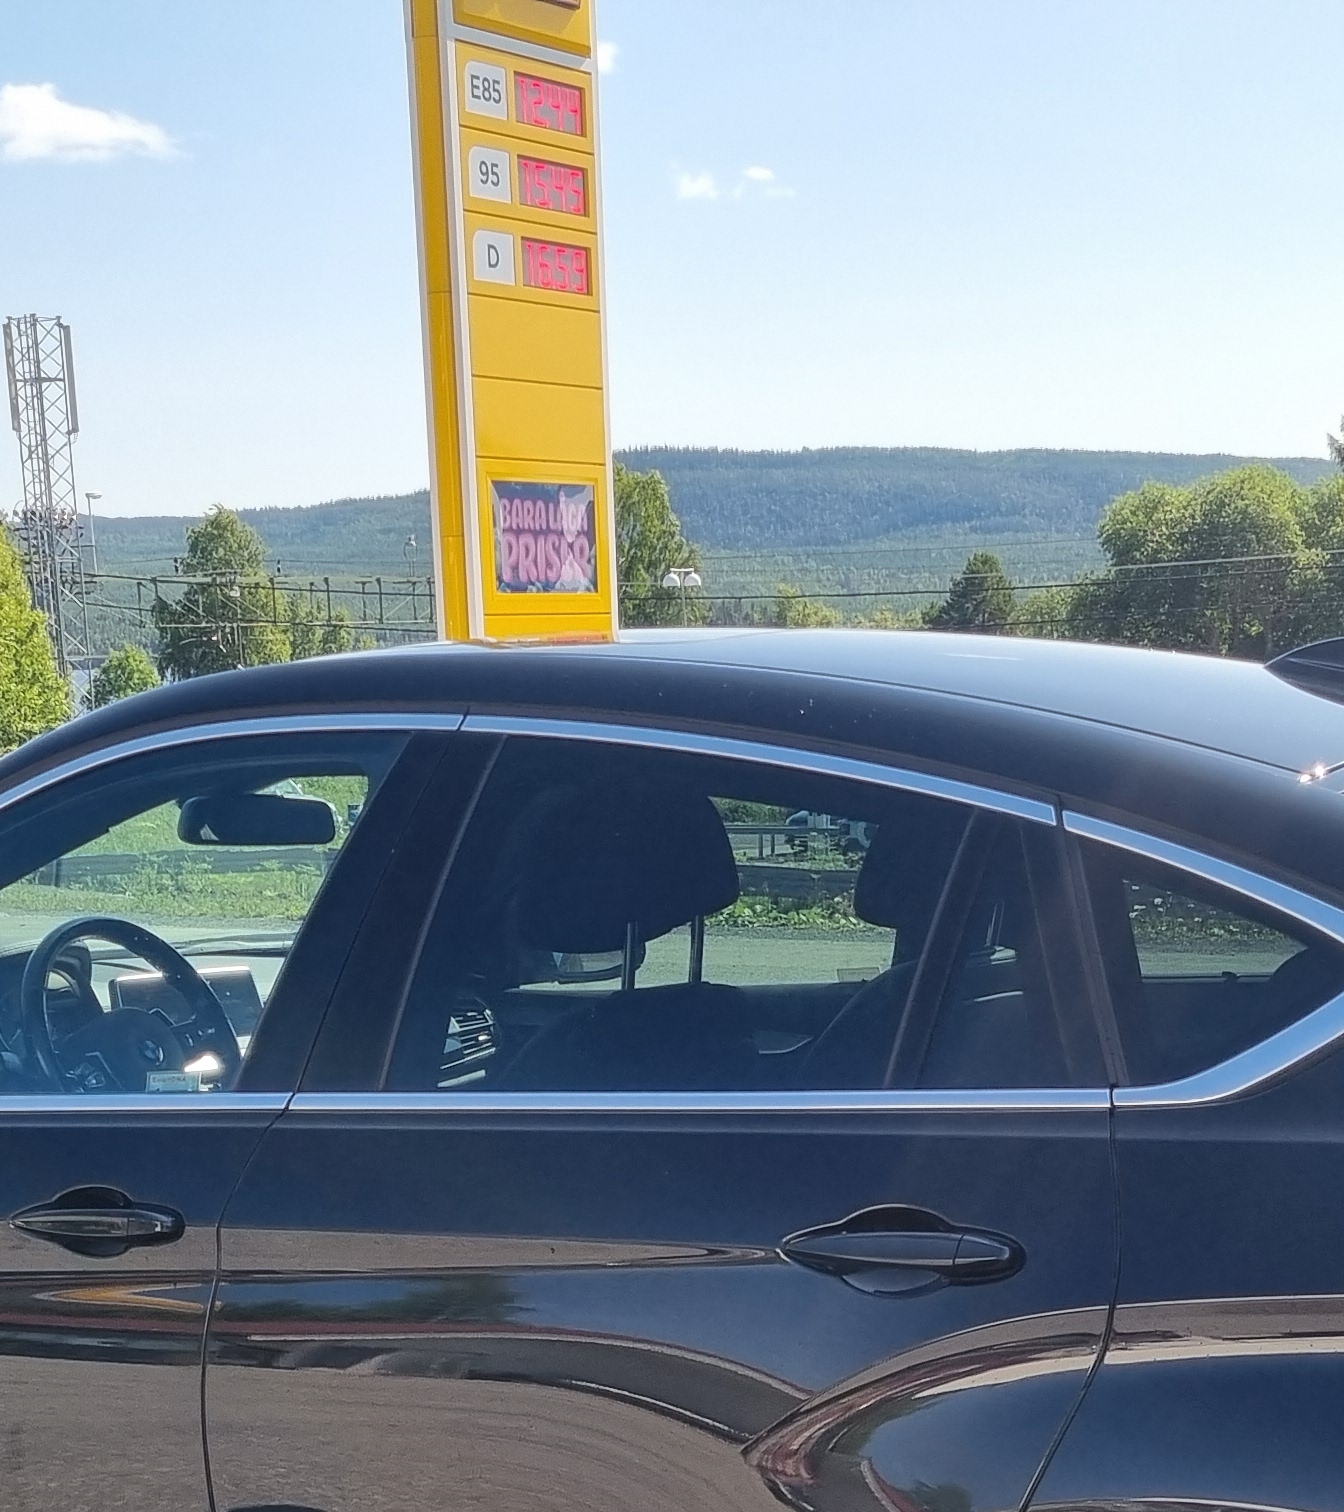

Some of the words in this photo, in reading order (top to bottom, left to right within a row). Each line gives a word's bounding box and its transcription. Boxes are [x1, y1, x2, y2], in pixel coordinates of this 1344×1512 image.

[469, 74, 502, 104] E85
[479, 160, 500, 187] 95
[487, 244, 500, 268] D
[500, 497, 547, 531] BARA
